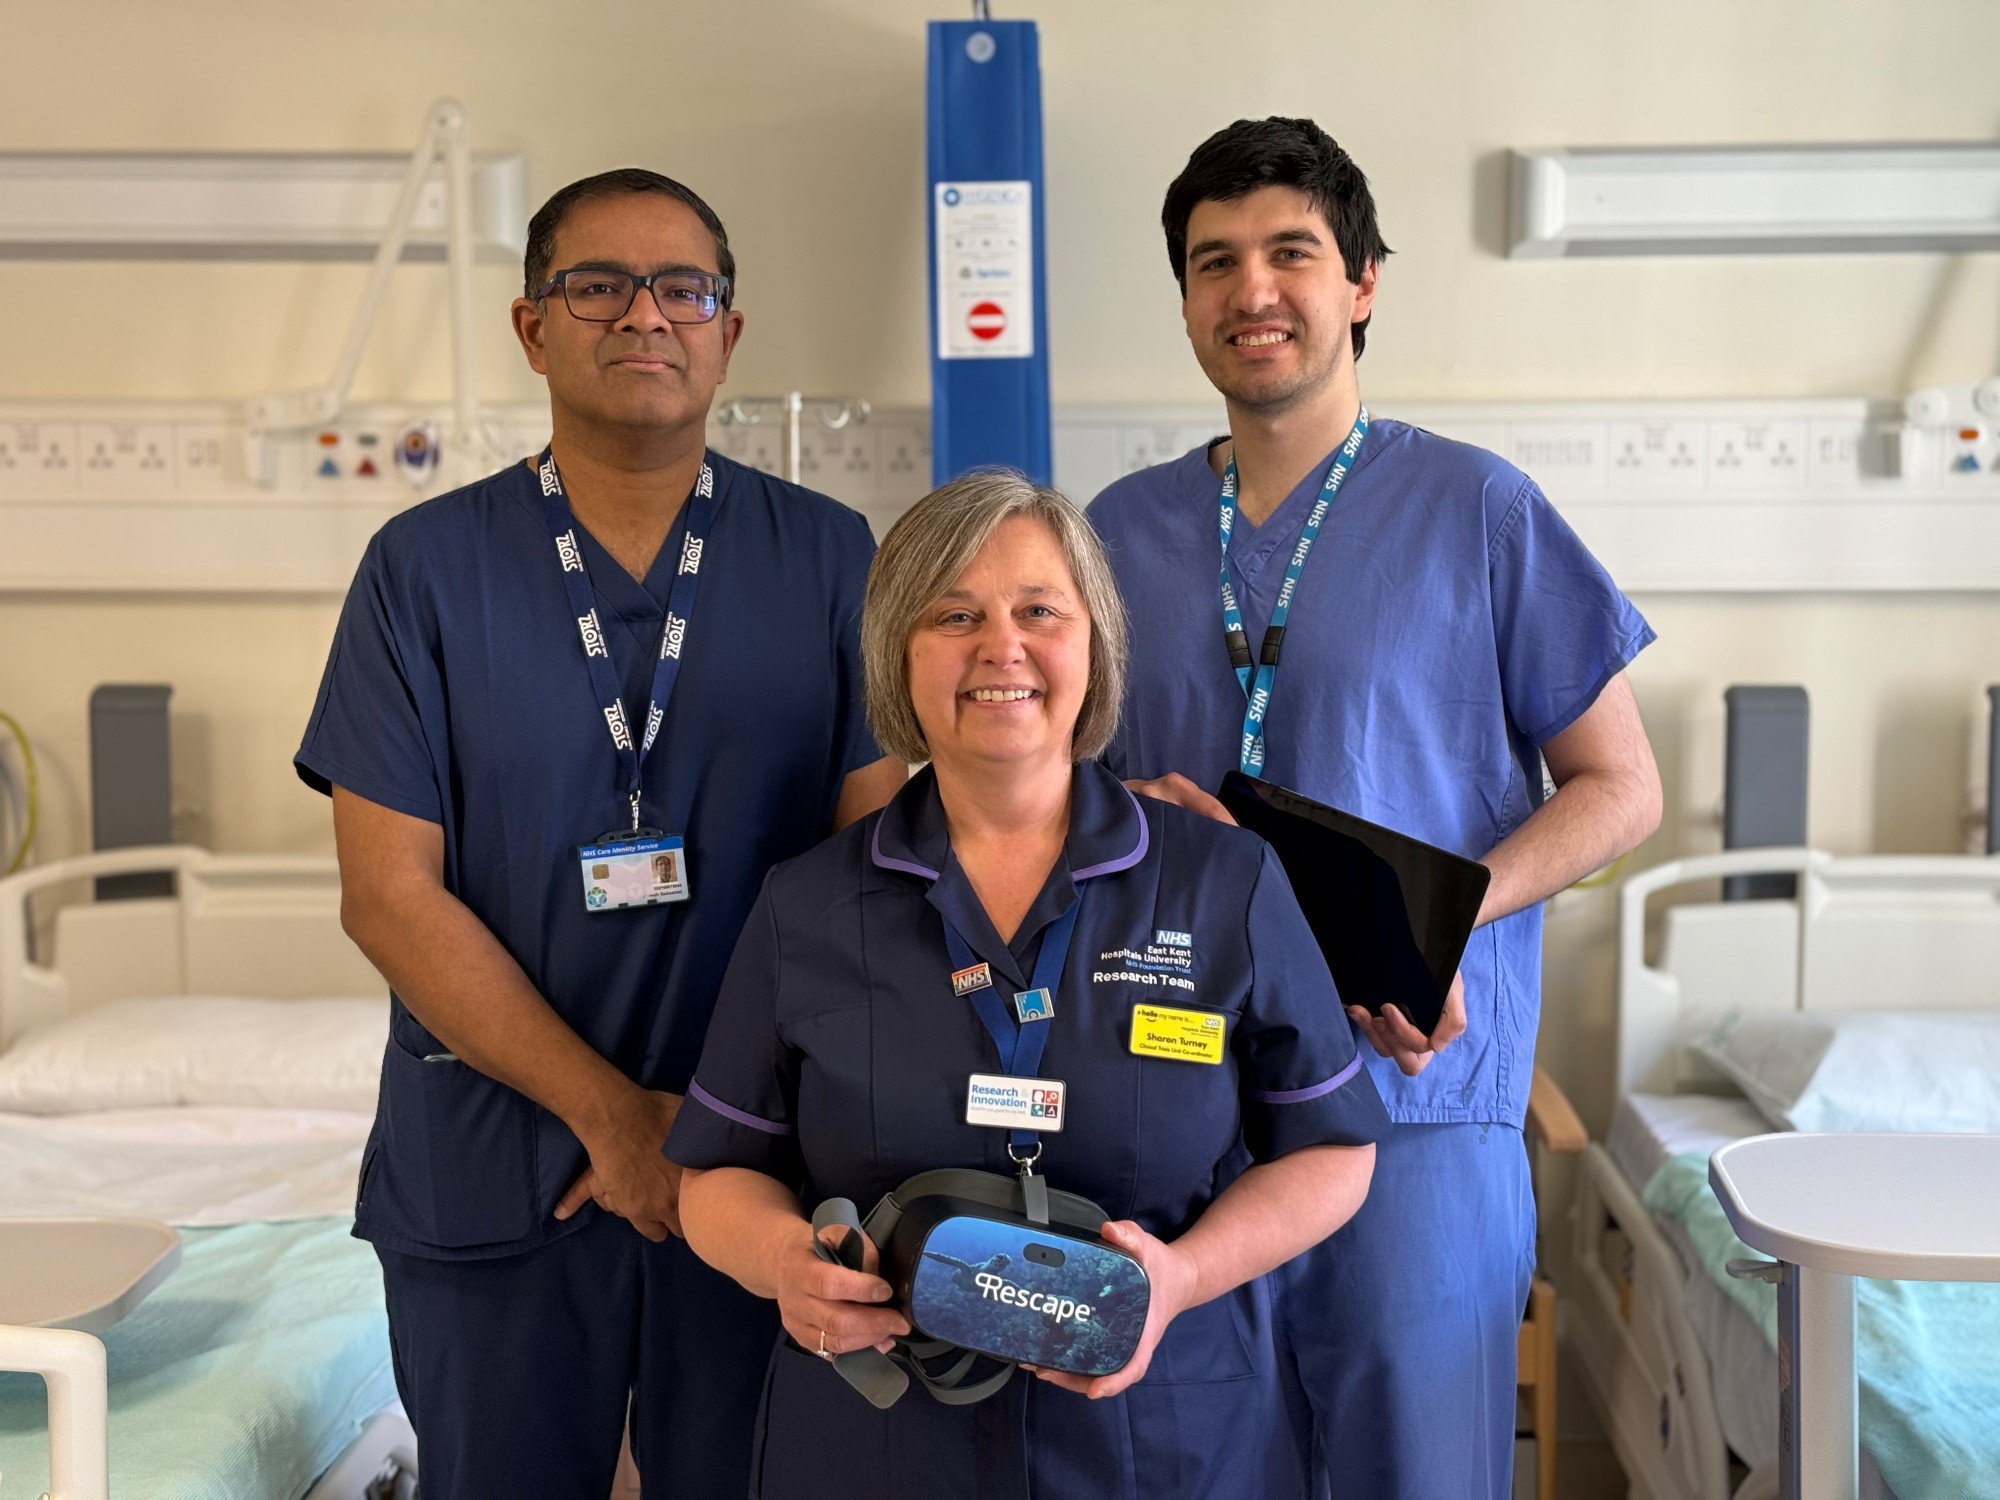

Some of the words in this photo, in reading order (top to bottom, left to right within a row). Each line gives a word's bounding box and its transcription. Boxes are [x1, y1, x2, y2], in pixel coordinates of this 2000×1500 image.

[540, 460, 556, 496] STORZ
[700, 463, 714, 498] STORZ
[1222, 474, 1234, 497] NHS
[1220, 504, 1232, 534] NHS
[556, 534, 578, 572] STORZ
[684, 536, 704, 574] STORZ
[1222, 582, 1236, 611] NHS
[578, 614, 602, 657] STORZ
[666, 617, 686, 660] STORZ
[604, 704, 628, 750] STORZ
[644, 707, 664, 750] STORZ
[1250, 736, 1262, 766] NHS
[612, 846, 636, 854] Identity
[637, 843, 658, 851] Service
[1147, 945, 1167, 955] East
[1170, 947, 1192, 958] Kent
[1157, 931, 1191, 946] NHS
[1101, 948, 1142, 960] Hospitals
[1144, 953, 1192, 968] University
[1126, 960, 1138, 968] NHS
[1139, 962, 1174, 972] Foundation
[1175, 965, 1192, 974] Trust
[957, 971, 985, 989] NHS
[1093, 972, 1158, 985] Research
[1160, 974, 1195, 991] Team
[1139, 1042, 1158, 1051] Clinical
[1146, 1032, 1177, 1045] Sharon
[1179, 1037, 1208, 1050] Turney
[971, 1095, 1027, 1108] Innovation
[972, 1084, 1018, 1097] Research
[975, 1272, 1091, 1323] Rescape
